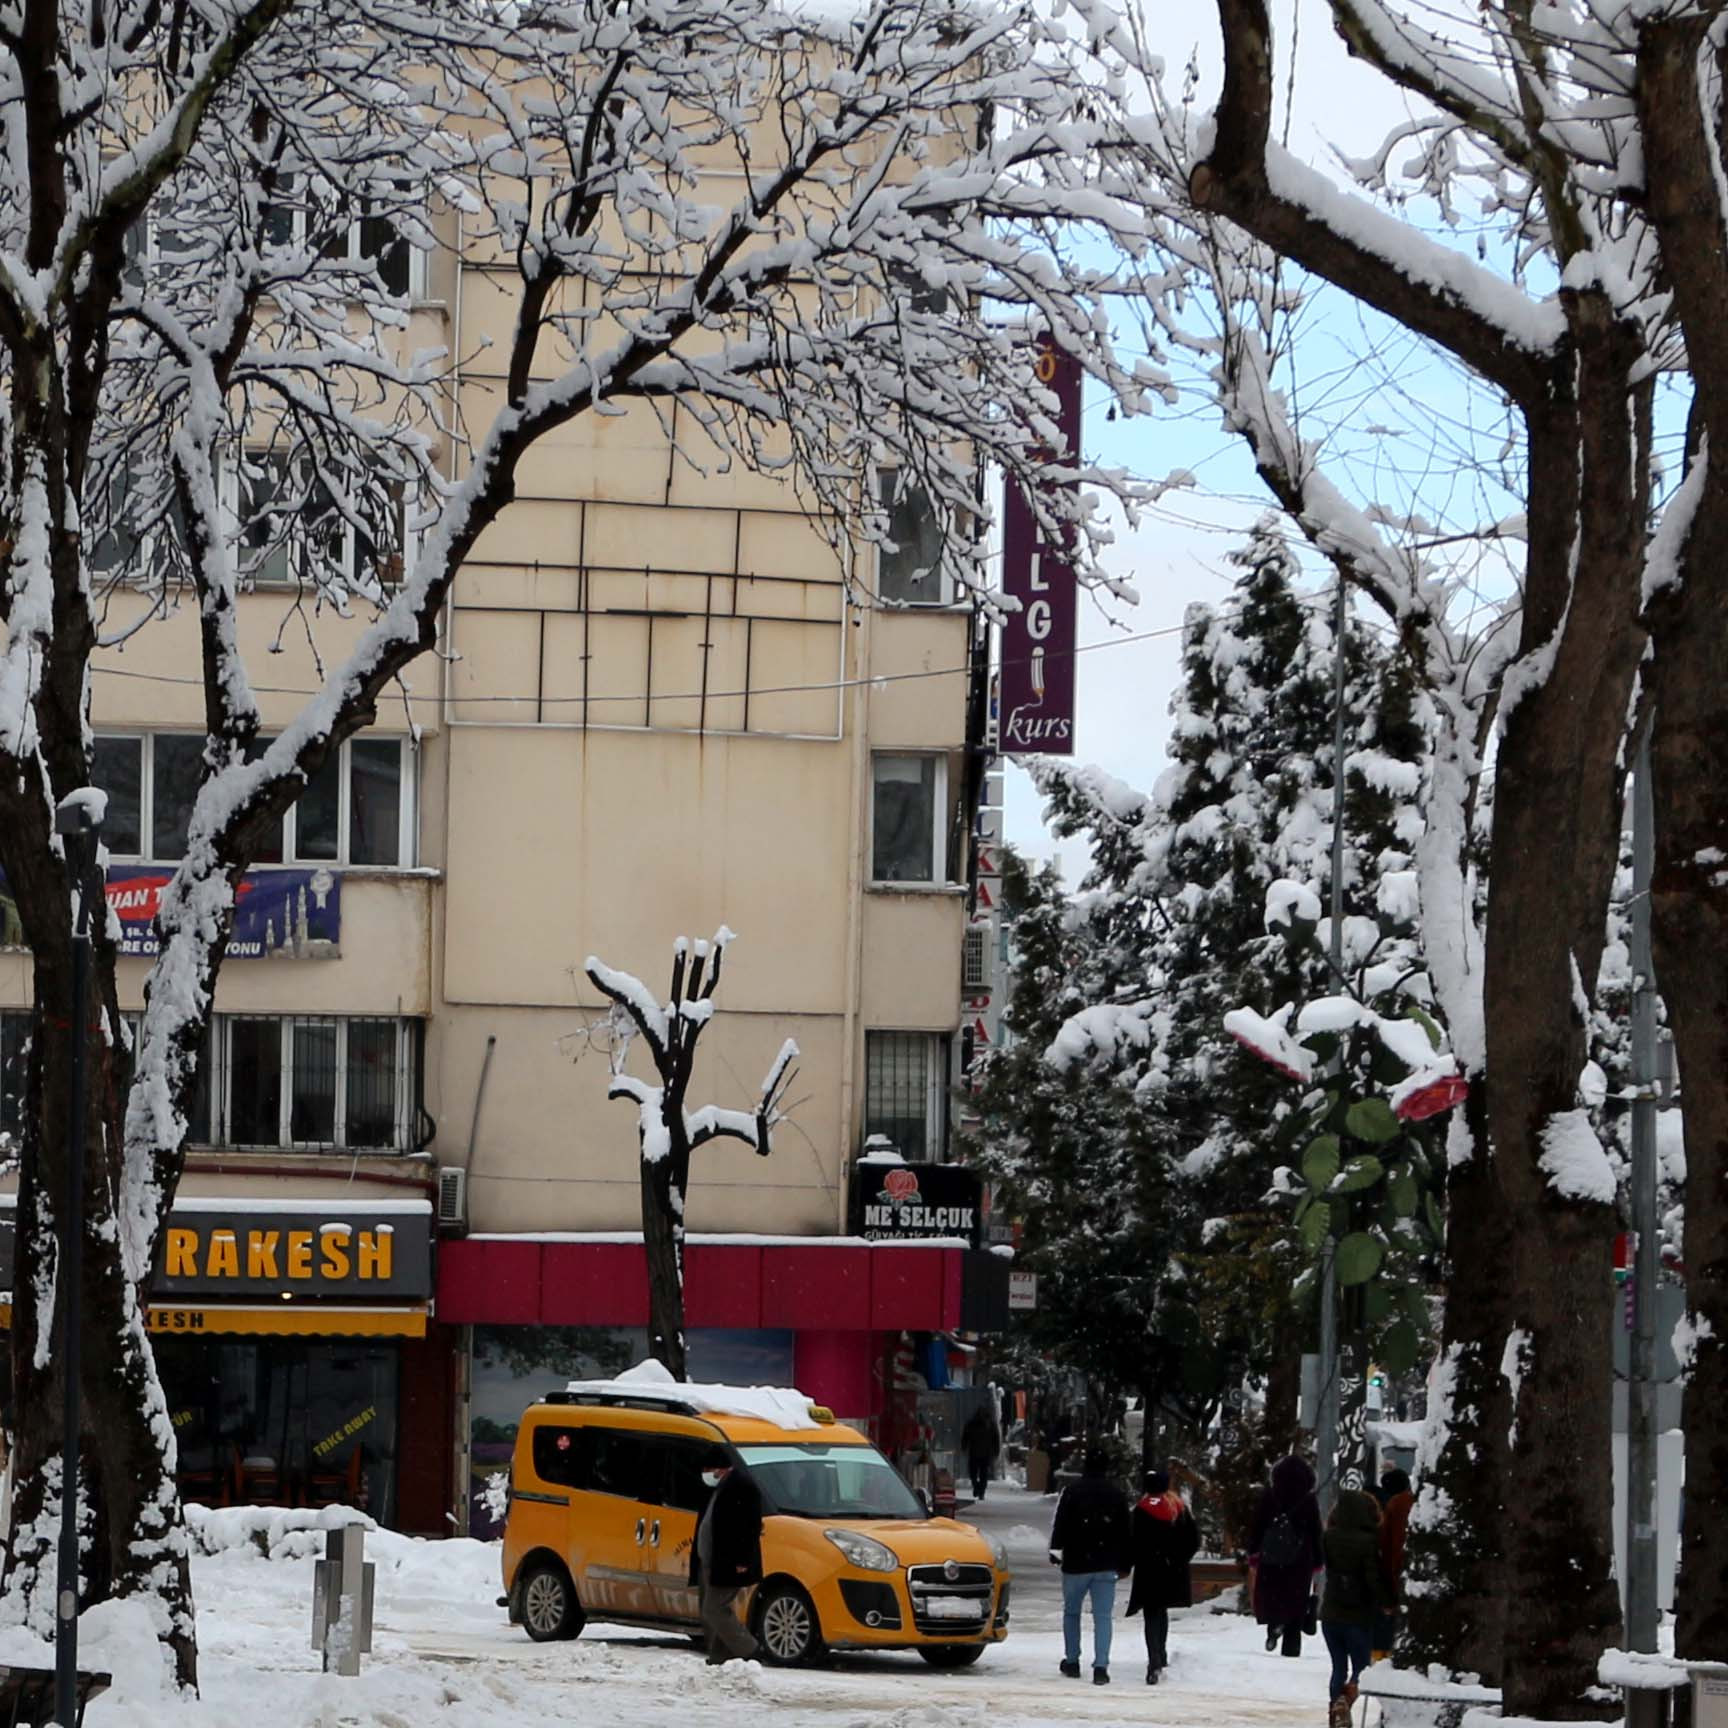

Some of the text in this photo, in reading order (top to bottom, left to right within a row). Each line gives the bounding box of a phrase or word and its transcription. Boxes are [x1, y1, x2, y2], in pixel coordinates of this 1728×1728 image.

[1005, 705, 1070, 746] kurs
[899, 1206, 974, 1232] SELÇUK
[165, 1228, 393, 1280] RAKESH
